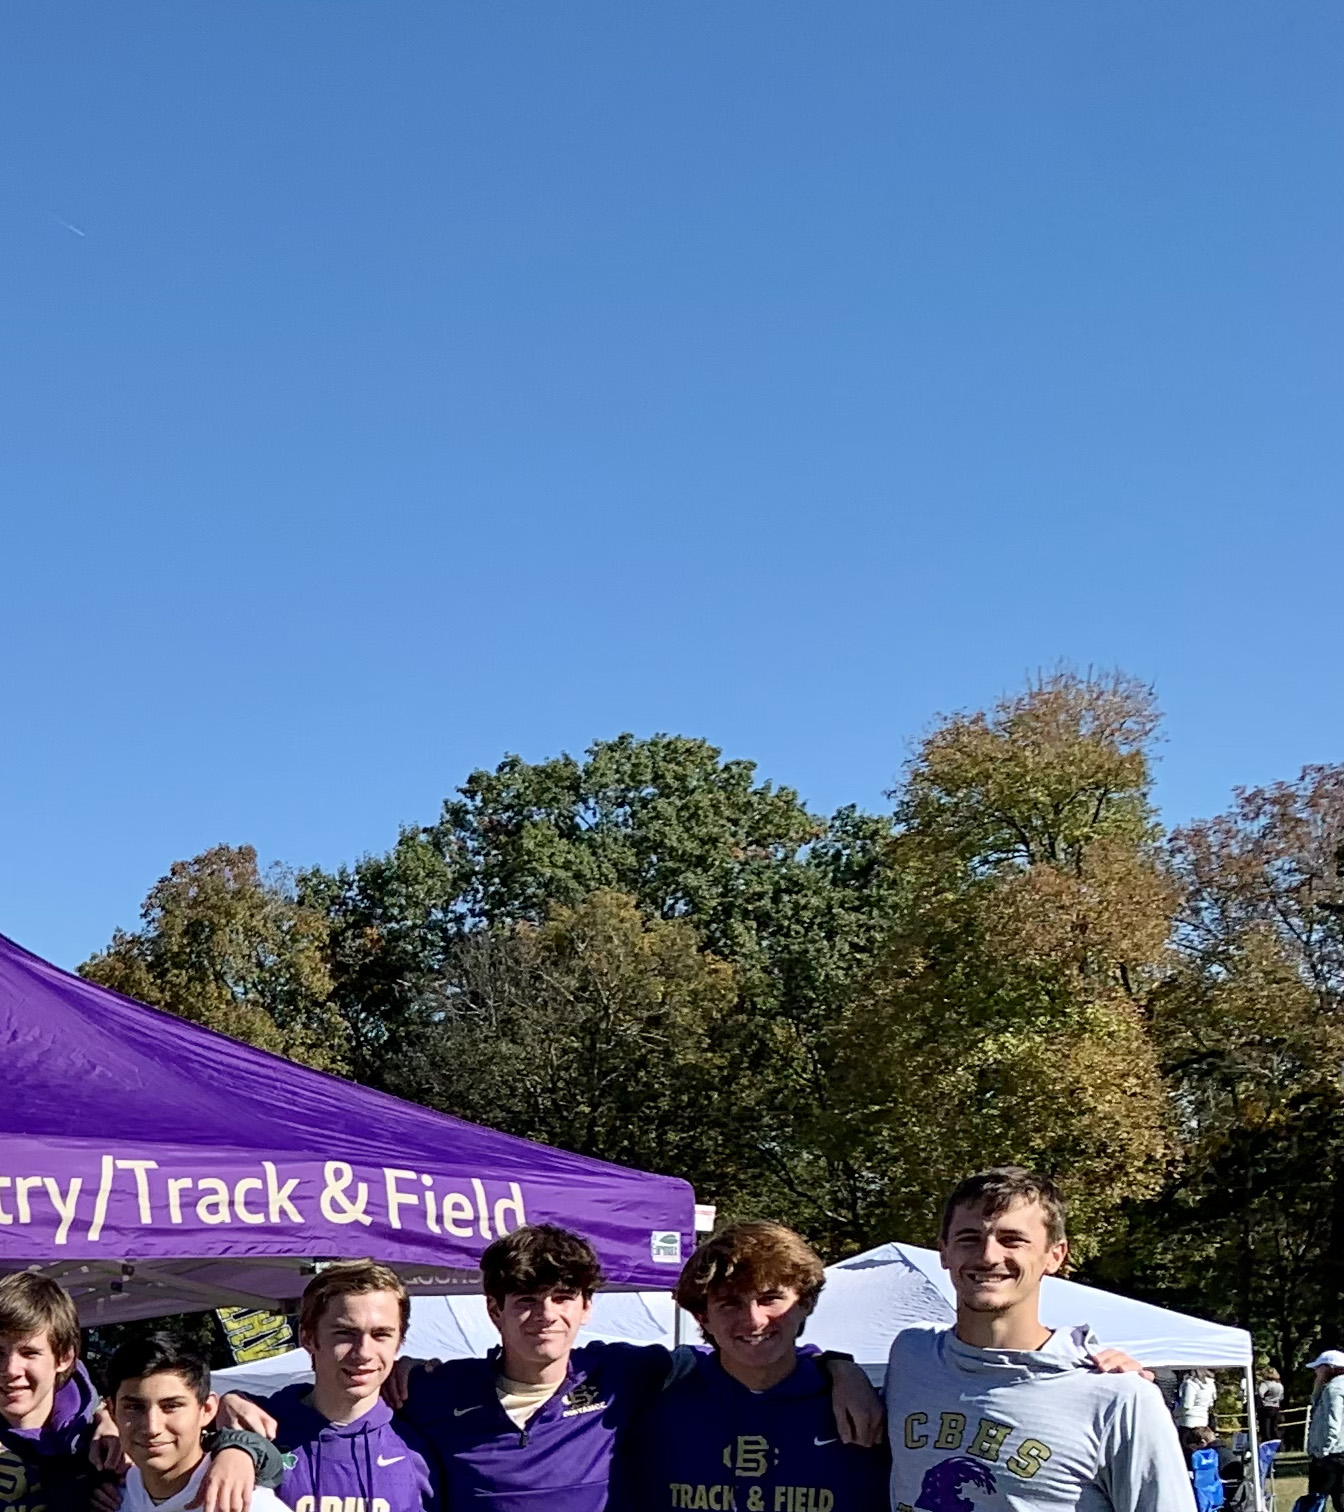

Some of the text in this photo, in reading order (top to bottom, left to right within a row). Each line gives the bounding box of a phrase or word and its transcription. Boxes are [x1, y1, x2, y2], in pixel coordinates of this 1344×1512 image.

[320, 1161, 373, 1226] &
[383, 1168, 528, 1240] Field
[904, 1412, 1052, 1479] CBHS
[746, 1485, 765, 1511] &
